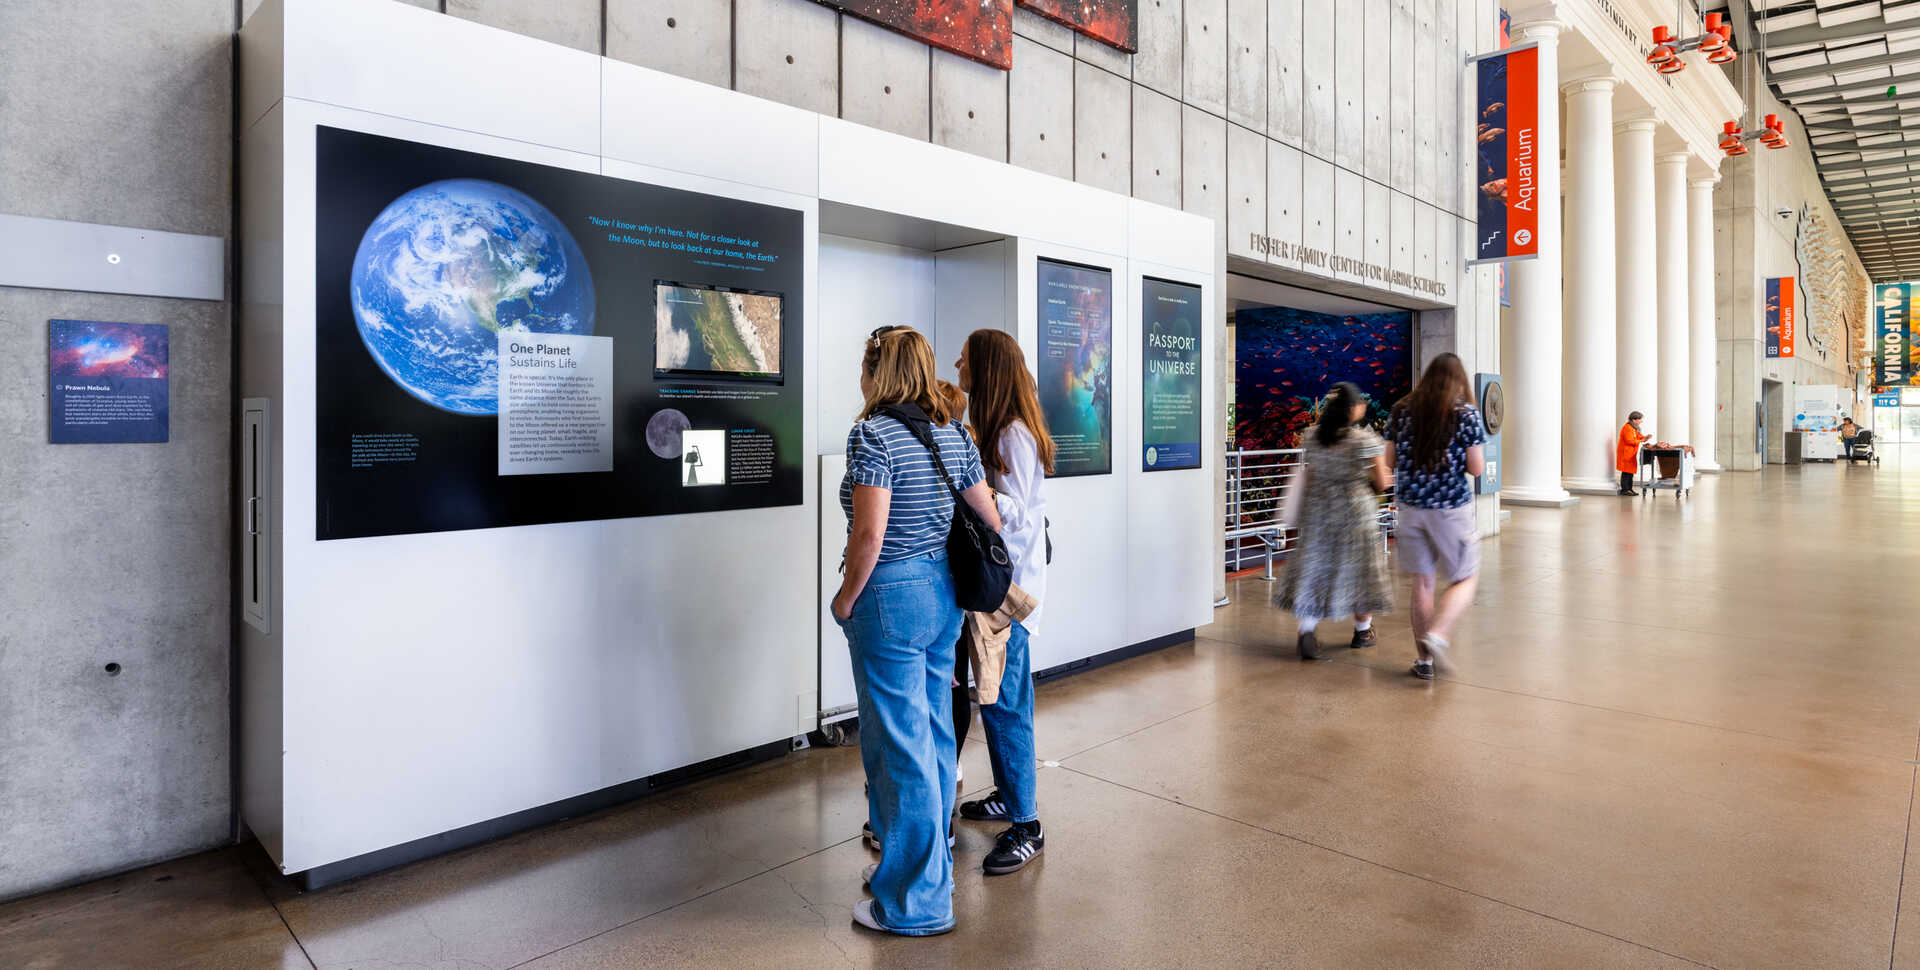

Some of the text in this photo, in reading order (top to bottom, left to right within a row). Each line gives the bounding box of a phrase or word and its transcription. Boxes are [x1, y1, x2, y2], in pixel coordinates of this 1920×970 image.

[1514, 128, 1535, 211] Aquarium
[608, 233, 621, 242] the
[622, 234, 646, 246] Moon,
[647, 239, 660, 248] but
[661, 240, 670, 248] to
[670, 241, 685, 251] look
[686, 242, 703, 253] back
[712, 248, 724, 256] our
[724, 248, 744, 259] home,
[745, 252, 756, 260] the
[616, 220, 636, 231] know
[638, 224, 652, 234] why
[654, 226, 666, 234] I'm
[667, 228, 684, 238] here.
[686, 230, 699, 240] Not
[700, 232, 710, 241] for
[716, 234, 737, 245] closer
[737, 236, 751, 247] look
[1250, 232, 1447, 297] FISHER FAMILY CENTER FOR MARINE SCIENCES
[1782, 307, 1793, 341] Aquarium
[1883, 287, 1902, 383] CALIFORNIA
[510, 342, 571, 356] One Planet
[1149, 333, 1196, 351] PASSPORT
[1166, 350, 1172, 358] TO
[510, 356, 577, 369] Sustains Life
[1149, 360, 1196, 376] UNIVERSE
